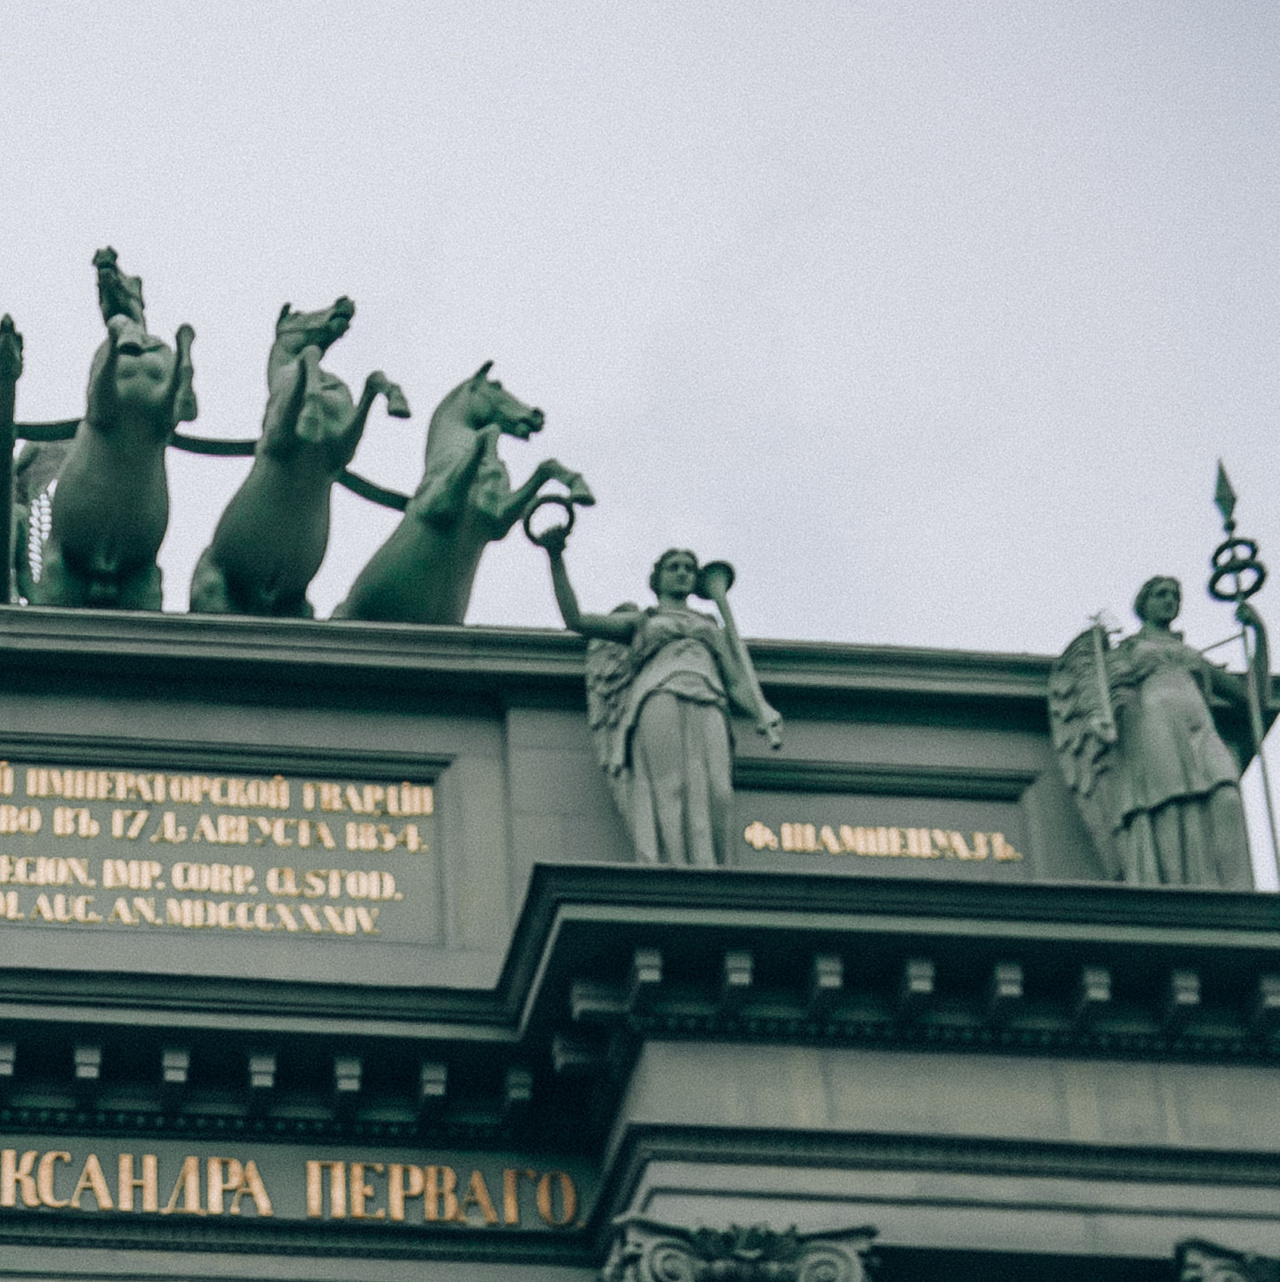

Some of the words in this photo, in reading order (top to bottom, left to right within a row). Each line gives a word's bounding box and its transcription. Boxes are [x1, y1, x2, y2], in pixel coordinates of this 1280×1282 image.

[25, 768, 291, 810] ИМПЕРАТОРСКОЙ
[52, 805, 101, 838] ВЪ
[110, 808, 149, 839] 17
[192, 813, 337, 850] АВГУСТА
[101, 858, 166, 891] IMP.
[170, 861, 259, 896] CORP.
